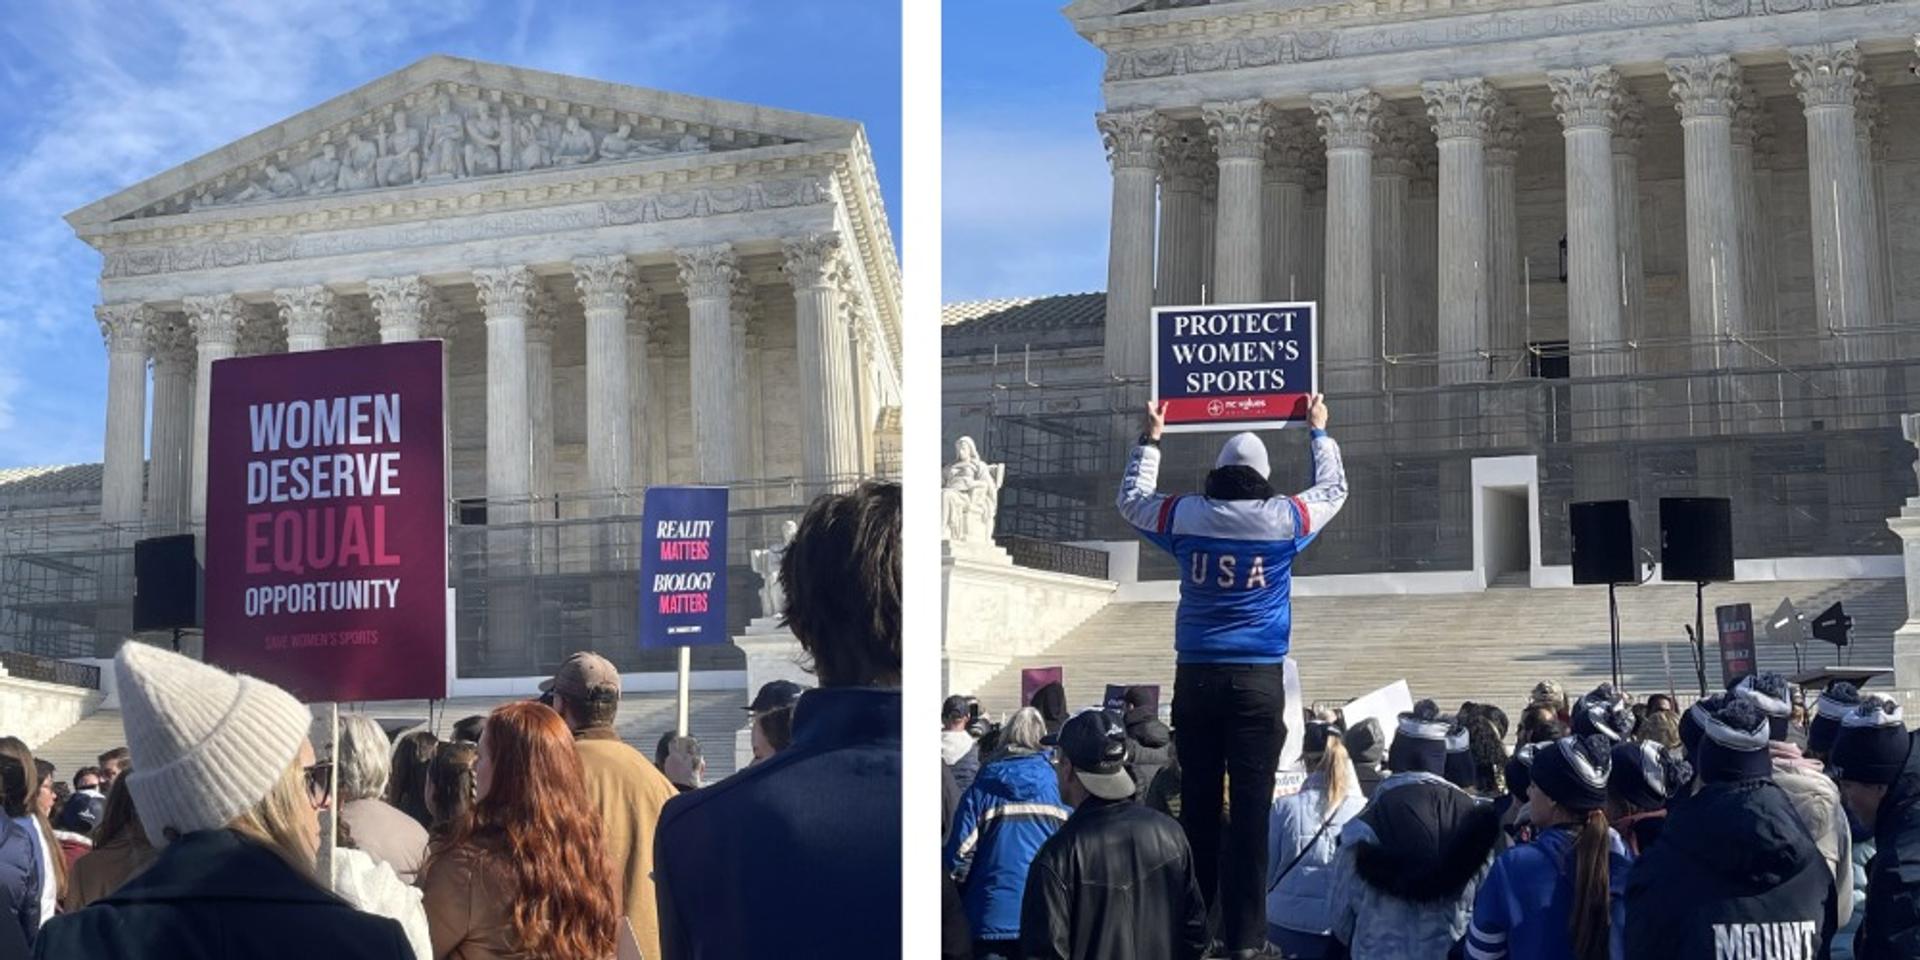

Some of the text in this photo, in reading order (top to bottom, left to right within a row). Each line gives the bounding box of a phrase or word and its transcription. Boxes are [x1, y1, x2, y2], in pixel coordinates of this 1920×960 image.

[1174, 311, 1297, 337] PROTECT
[1172, 340, 1299, 365] WOMEN'S
[1186, 368, 1285, 394] SPORTS
[250, 393, 400, 452] WOMEN
[248, 452, 400, 505] DESERVE
[245, 505, 400, 575] EQUAL
[656, 519, 715, 540] REALITY
[660, 540, 710, 561] MATTERS
[653, 572, 716, 593] BIOLOGY
[1192, 551, 1267, 589] USA
[245, 578, 400, 617] OPPORTUNITY
[658, 593, 709, 615] MATTERS
[339, 629, 379, 646] SPORTS
[1712, 920, 1815, 960] MOUNT
